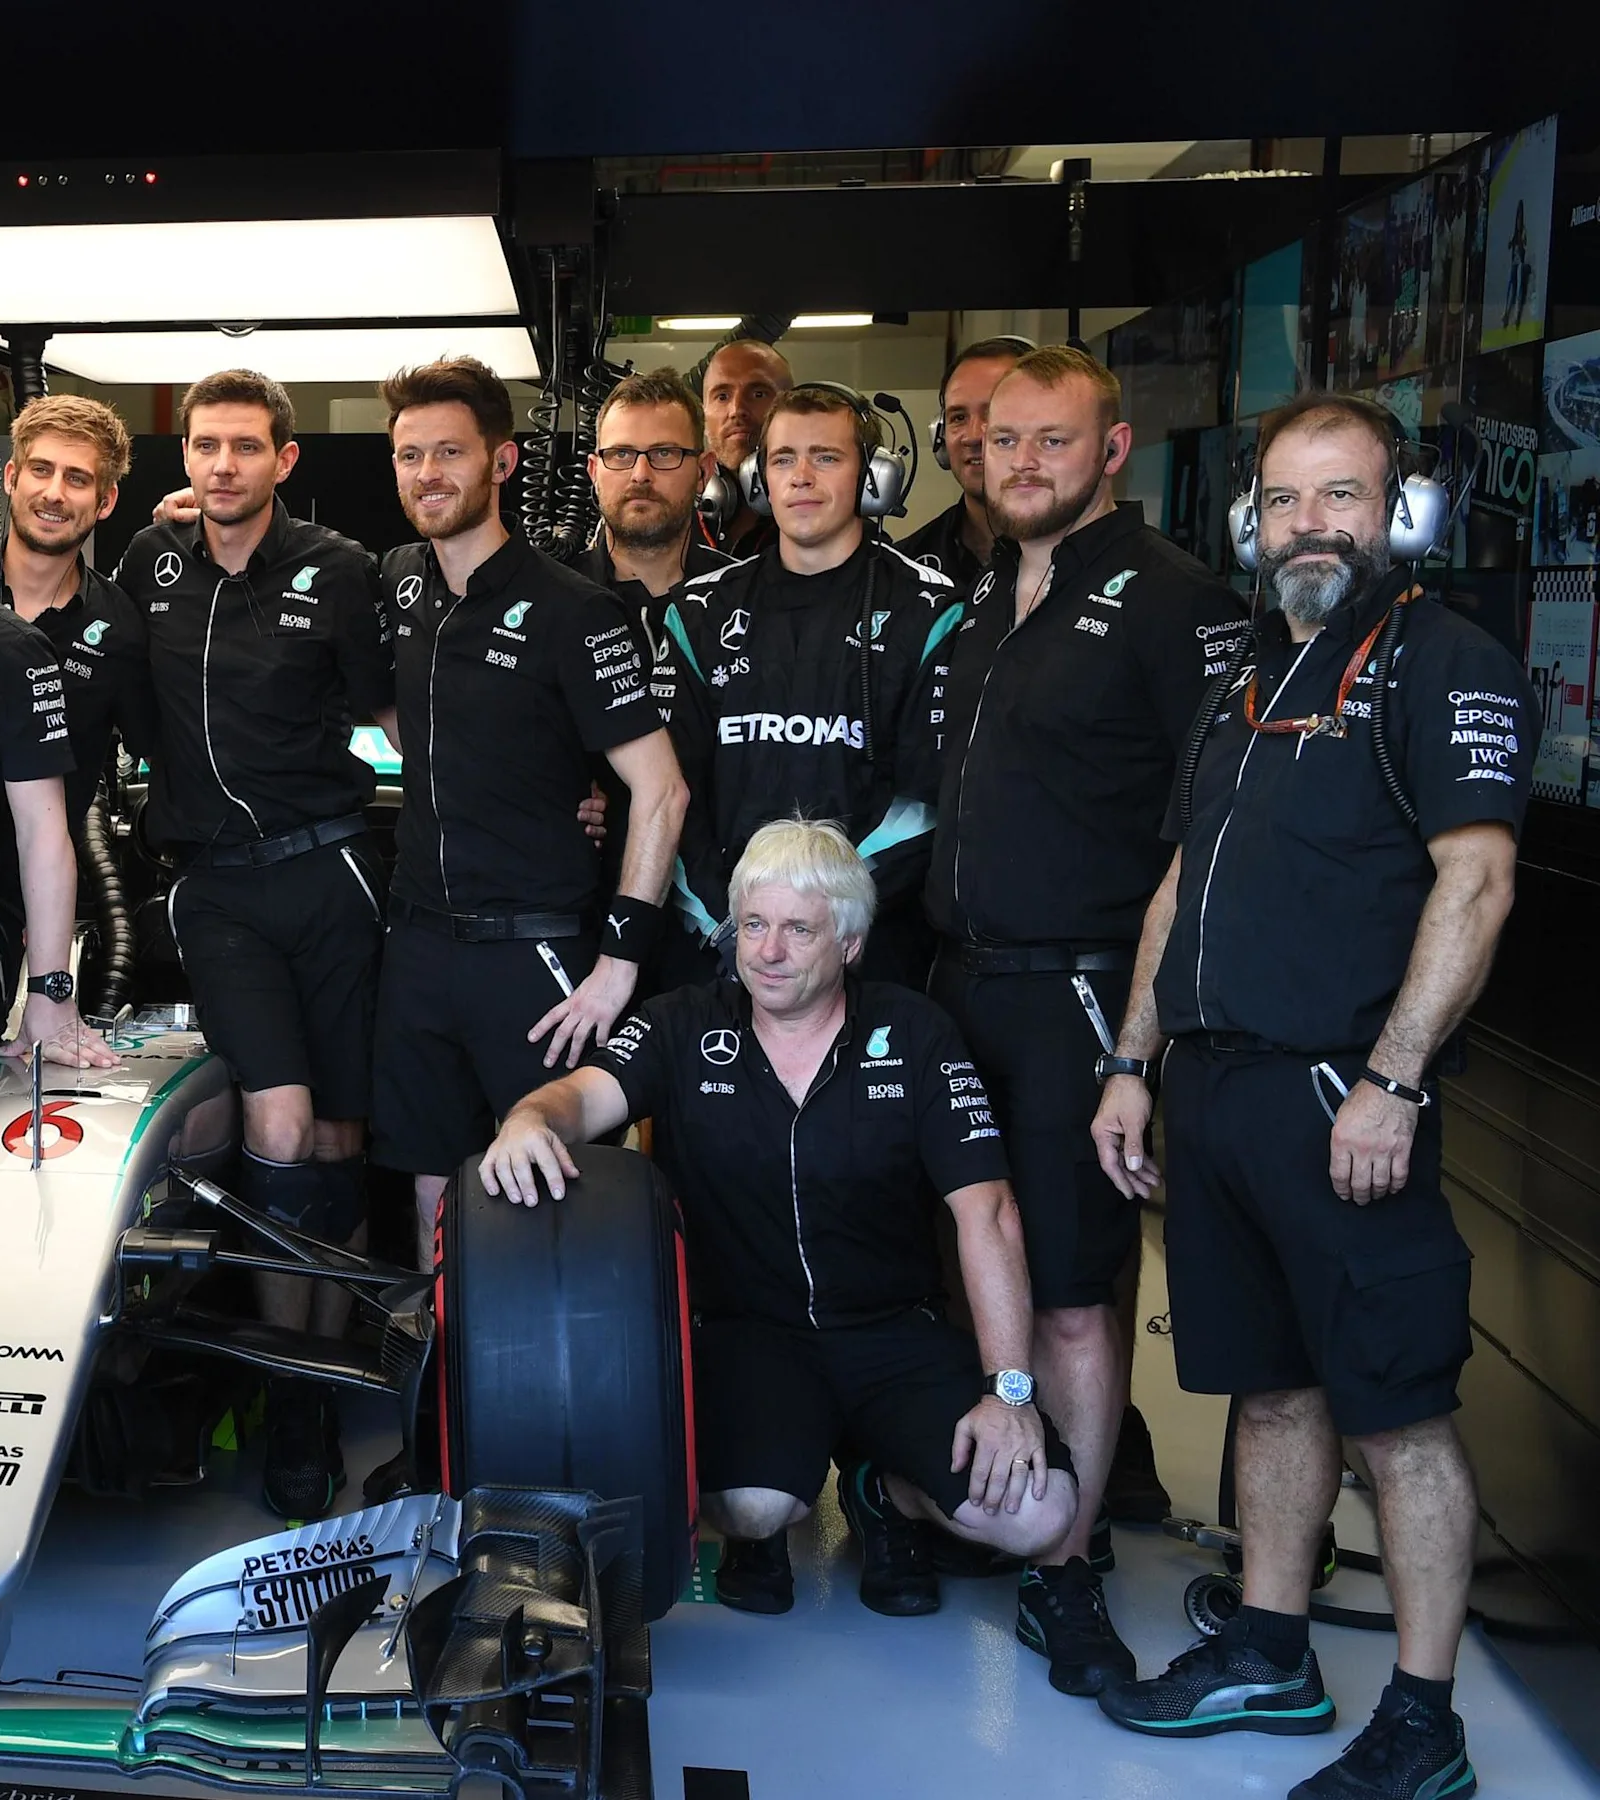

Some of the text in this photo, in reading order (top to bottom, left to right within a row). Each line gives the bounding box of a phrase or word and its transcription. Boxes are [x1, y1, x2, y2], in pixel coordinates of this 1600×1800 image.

[1475, 416, 1499, 441] TEAM
[282, 592, 319, 604] PETRONAS
[1088, 593, 1123, 608] PETRONAS
[280, 613, 311, 625] BOSS
[1078, 616, 1109, 633] BOSS
[492, 627, 527, 641] PETRONAS
[585, 624, 629, 648] QUALCOMM
[593, 639, 634, 663] EPSON
[1204, 638, 1241, 658] EPS
[487, 649, 518, 666] BOSS
[65, 658, 93, 676] BOSS
[595, 661, 633, 681] Allianz
[1204, 661, 1228, 677] Alli
[611, 673, 640, 694] IWC
[604, 685, 648, 710] BOSE
[1448, 691, 1519, 708] QUALCOMM
[1341, 700, 1372, 713] BOS
[46, 712, 66, 728] IWC
[1455, 710, 1514, 730] EPSON
[39, 728, 69, 742] BOS
[718, 713, 865, 749] ETRONAS
[1450, 730, 1504, 746] Allianz
[1469, 749, 1509, 767] IWC
[1455, 769, 1516, 786] BOSE
[860, 1058, 903, 1069] PETRONAS
[713, 1083, 735, 1095] UBS
[868, 1084, 904, 1095] BOSS
[949, 1077, 984, 1092] EPSO
[968, 1110, 994, 1125] IWC
[2, 1100, 83, 1160] 6
[244, 1534, 375, 1577] PETRONAS
